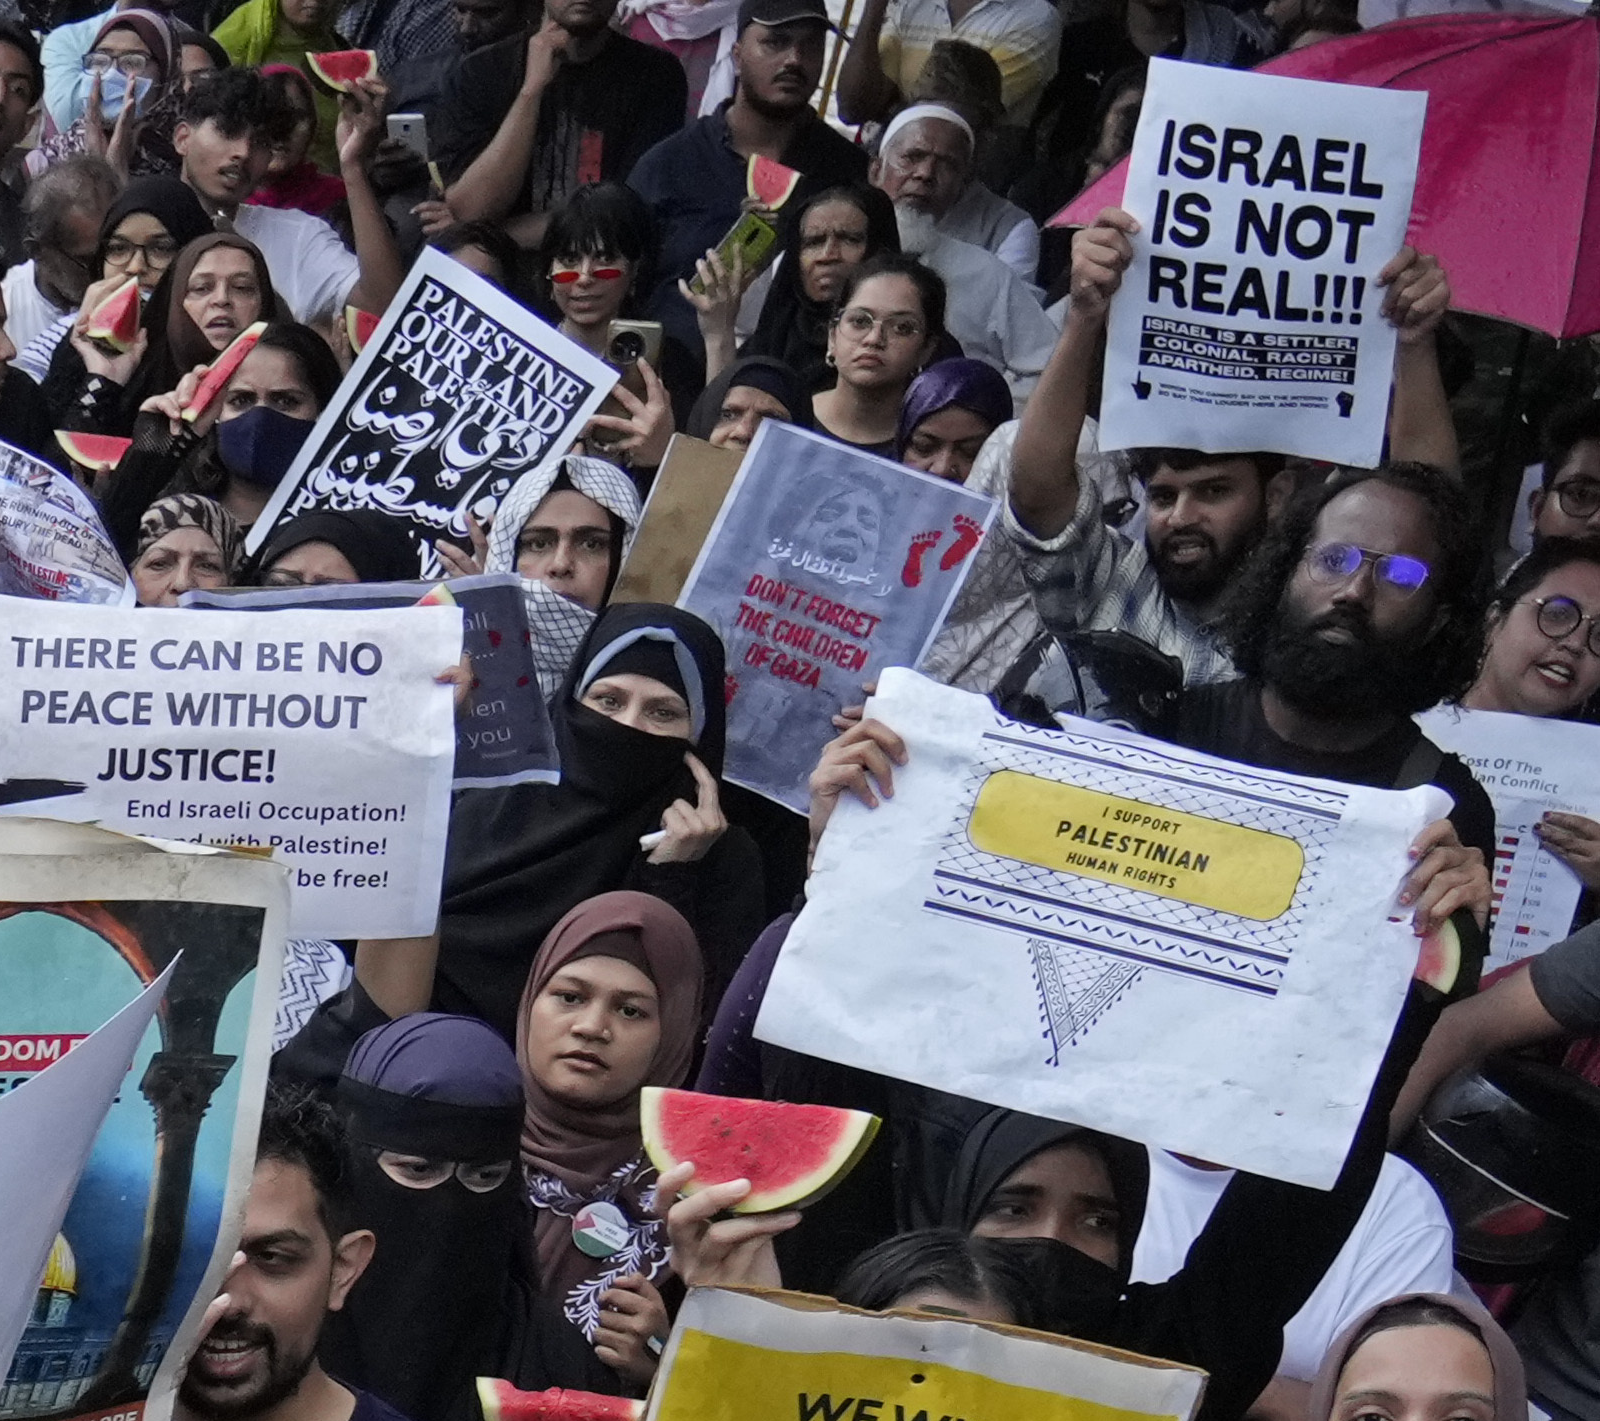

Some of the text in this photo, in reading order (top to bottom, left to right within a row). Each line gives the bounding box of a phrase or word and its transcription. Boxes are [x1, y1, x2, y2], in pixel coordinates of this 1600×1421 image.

[1156, 119, 1384, 200] ISRAEL
[1151, 188, 1376, 265] IS NOT
[1147, 254, 1367, 325] REAL!!!
[399, 308, 474, 374] OUR
[411, 279, 585, 412] PALESTINE
[1145, 316, 1212, 340] ISRAEL
[1216, 330, 1237, 344] IS
[1241, 332, 1258, 346] A
[1146, 351, 1350, 383] APARTHEID, REGIME!
[1265, 351, 1347, 366] RACIST
[1213, 398, 1251, 408] LOUDER
[1, 515, 52, 538] BURY THE
[8, 501, 59, 526] RUNNING
[22, 557, 70, 588] PALESTINE
[744, 573, 883, 640] DON'T FORGET
[734, 601, 870, 673] THE CHILDREN
[10, 635, 384, 677] THERE CAN BE NO
[743, 641, 822, 690] OF GAZA
[19, 688, 369, 731] PEACE WITHOUT
[466, 723, 512, 748] you
[96, 747, 277, 784] JUSTICE!
[1493, 757, 1513, 771] Of
[1515, 760, 1543, 776] The
[1499, 774, 1560, 795] Conflict
[126, 799, 407, 827] End Israeli Occupation!
[1102, 806, 1183, 836] I SUPPORT
[268, 833, 388, 856] Palestine!
[1054, 819, 1212, 874] PALESTINIAN
[296, 867, 390, 889] be free!
[1065, 851, 1178, 890] HUMAN RIGHTS
